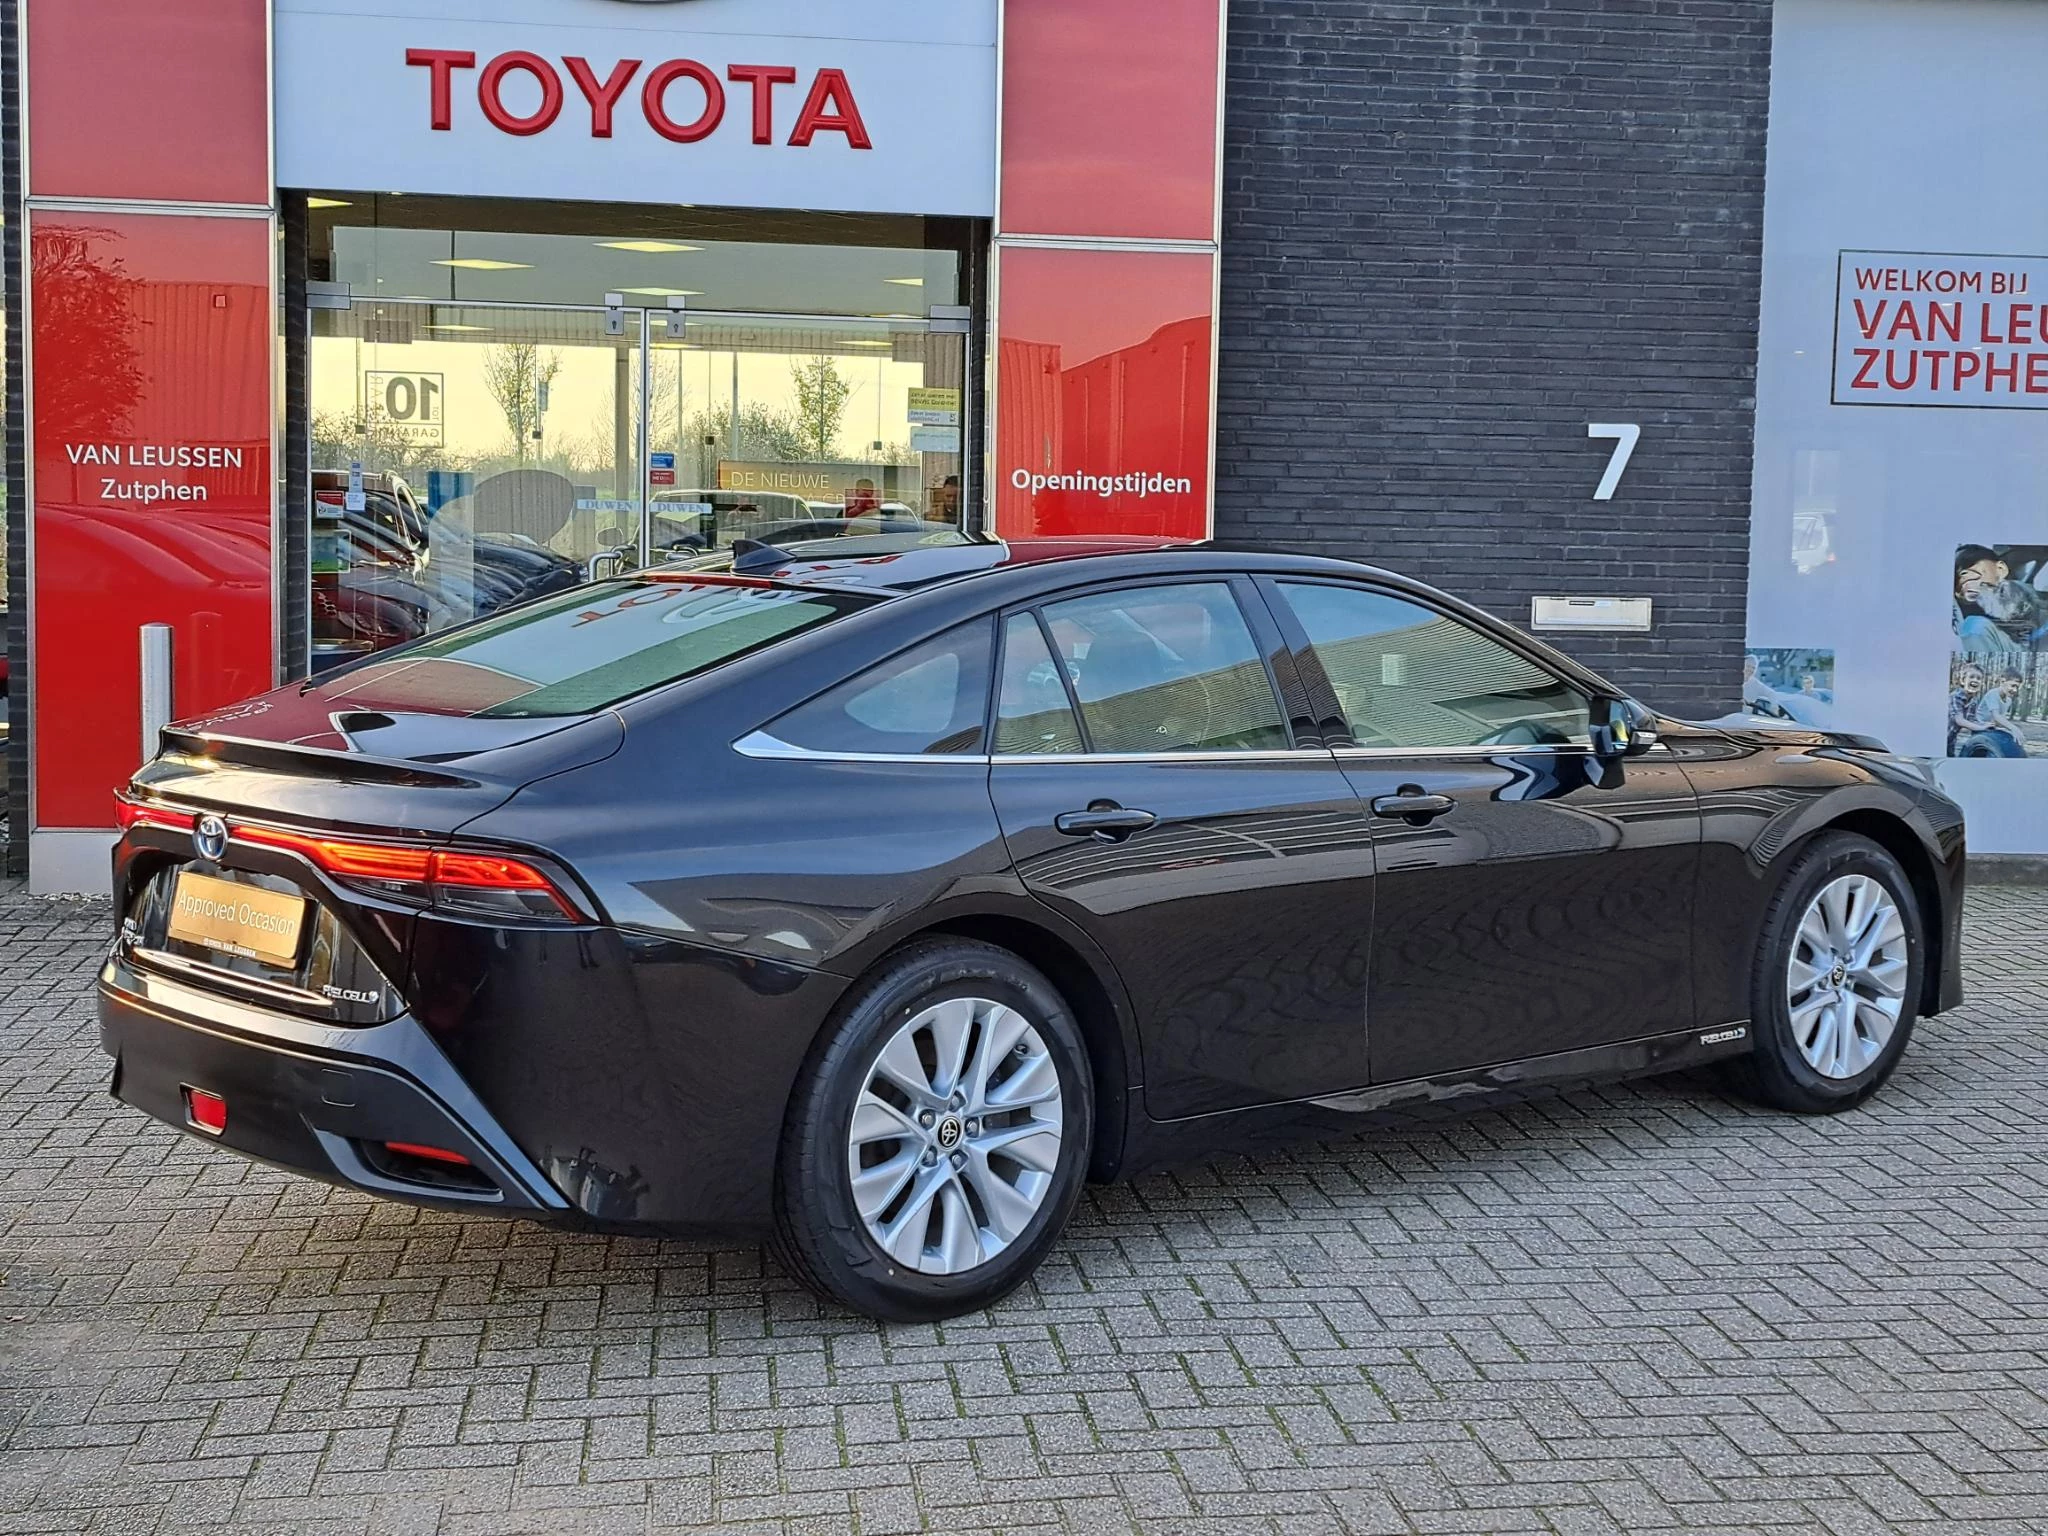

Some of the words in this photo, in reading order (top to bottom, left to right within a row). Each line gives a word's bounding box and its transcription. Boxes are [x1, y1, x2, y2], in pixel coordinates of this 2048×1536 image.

[405, 47, 872, 150] TOYOTA
[1855, 267, 1982, 294] WELKOM
[1991, 271, 2028, 294] BIJ
[1853, 298, 1962, 342] VAN
[65, 444, 120, 465] VAN
[129, 445, 242, 468] LEUSSEN
[1588, 423, 1641, 500] 7
[101, 478, 208, 505] Zutphen
[731, 471, 754, 487] DE
[760, 473, 829, 489] NIEUWE
[1012, 468, 1191, 498] Openingstijden
[586, 500, 632, 511] DUWEN
[658, 502, 704, 513] DUWEN
[177, 890, 237, 921] Approved
[239, 903, 296, 936] Occasion
